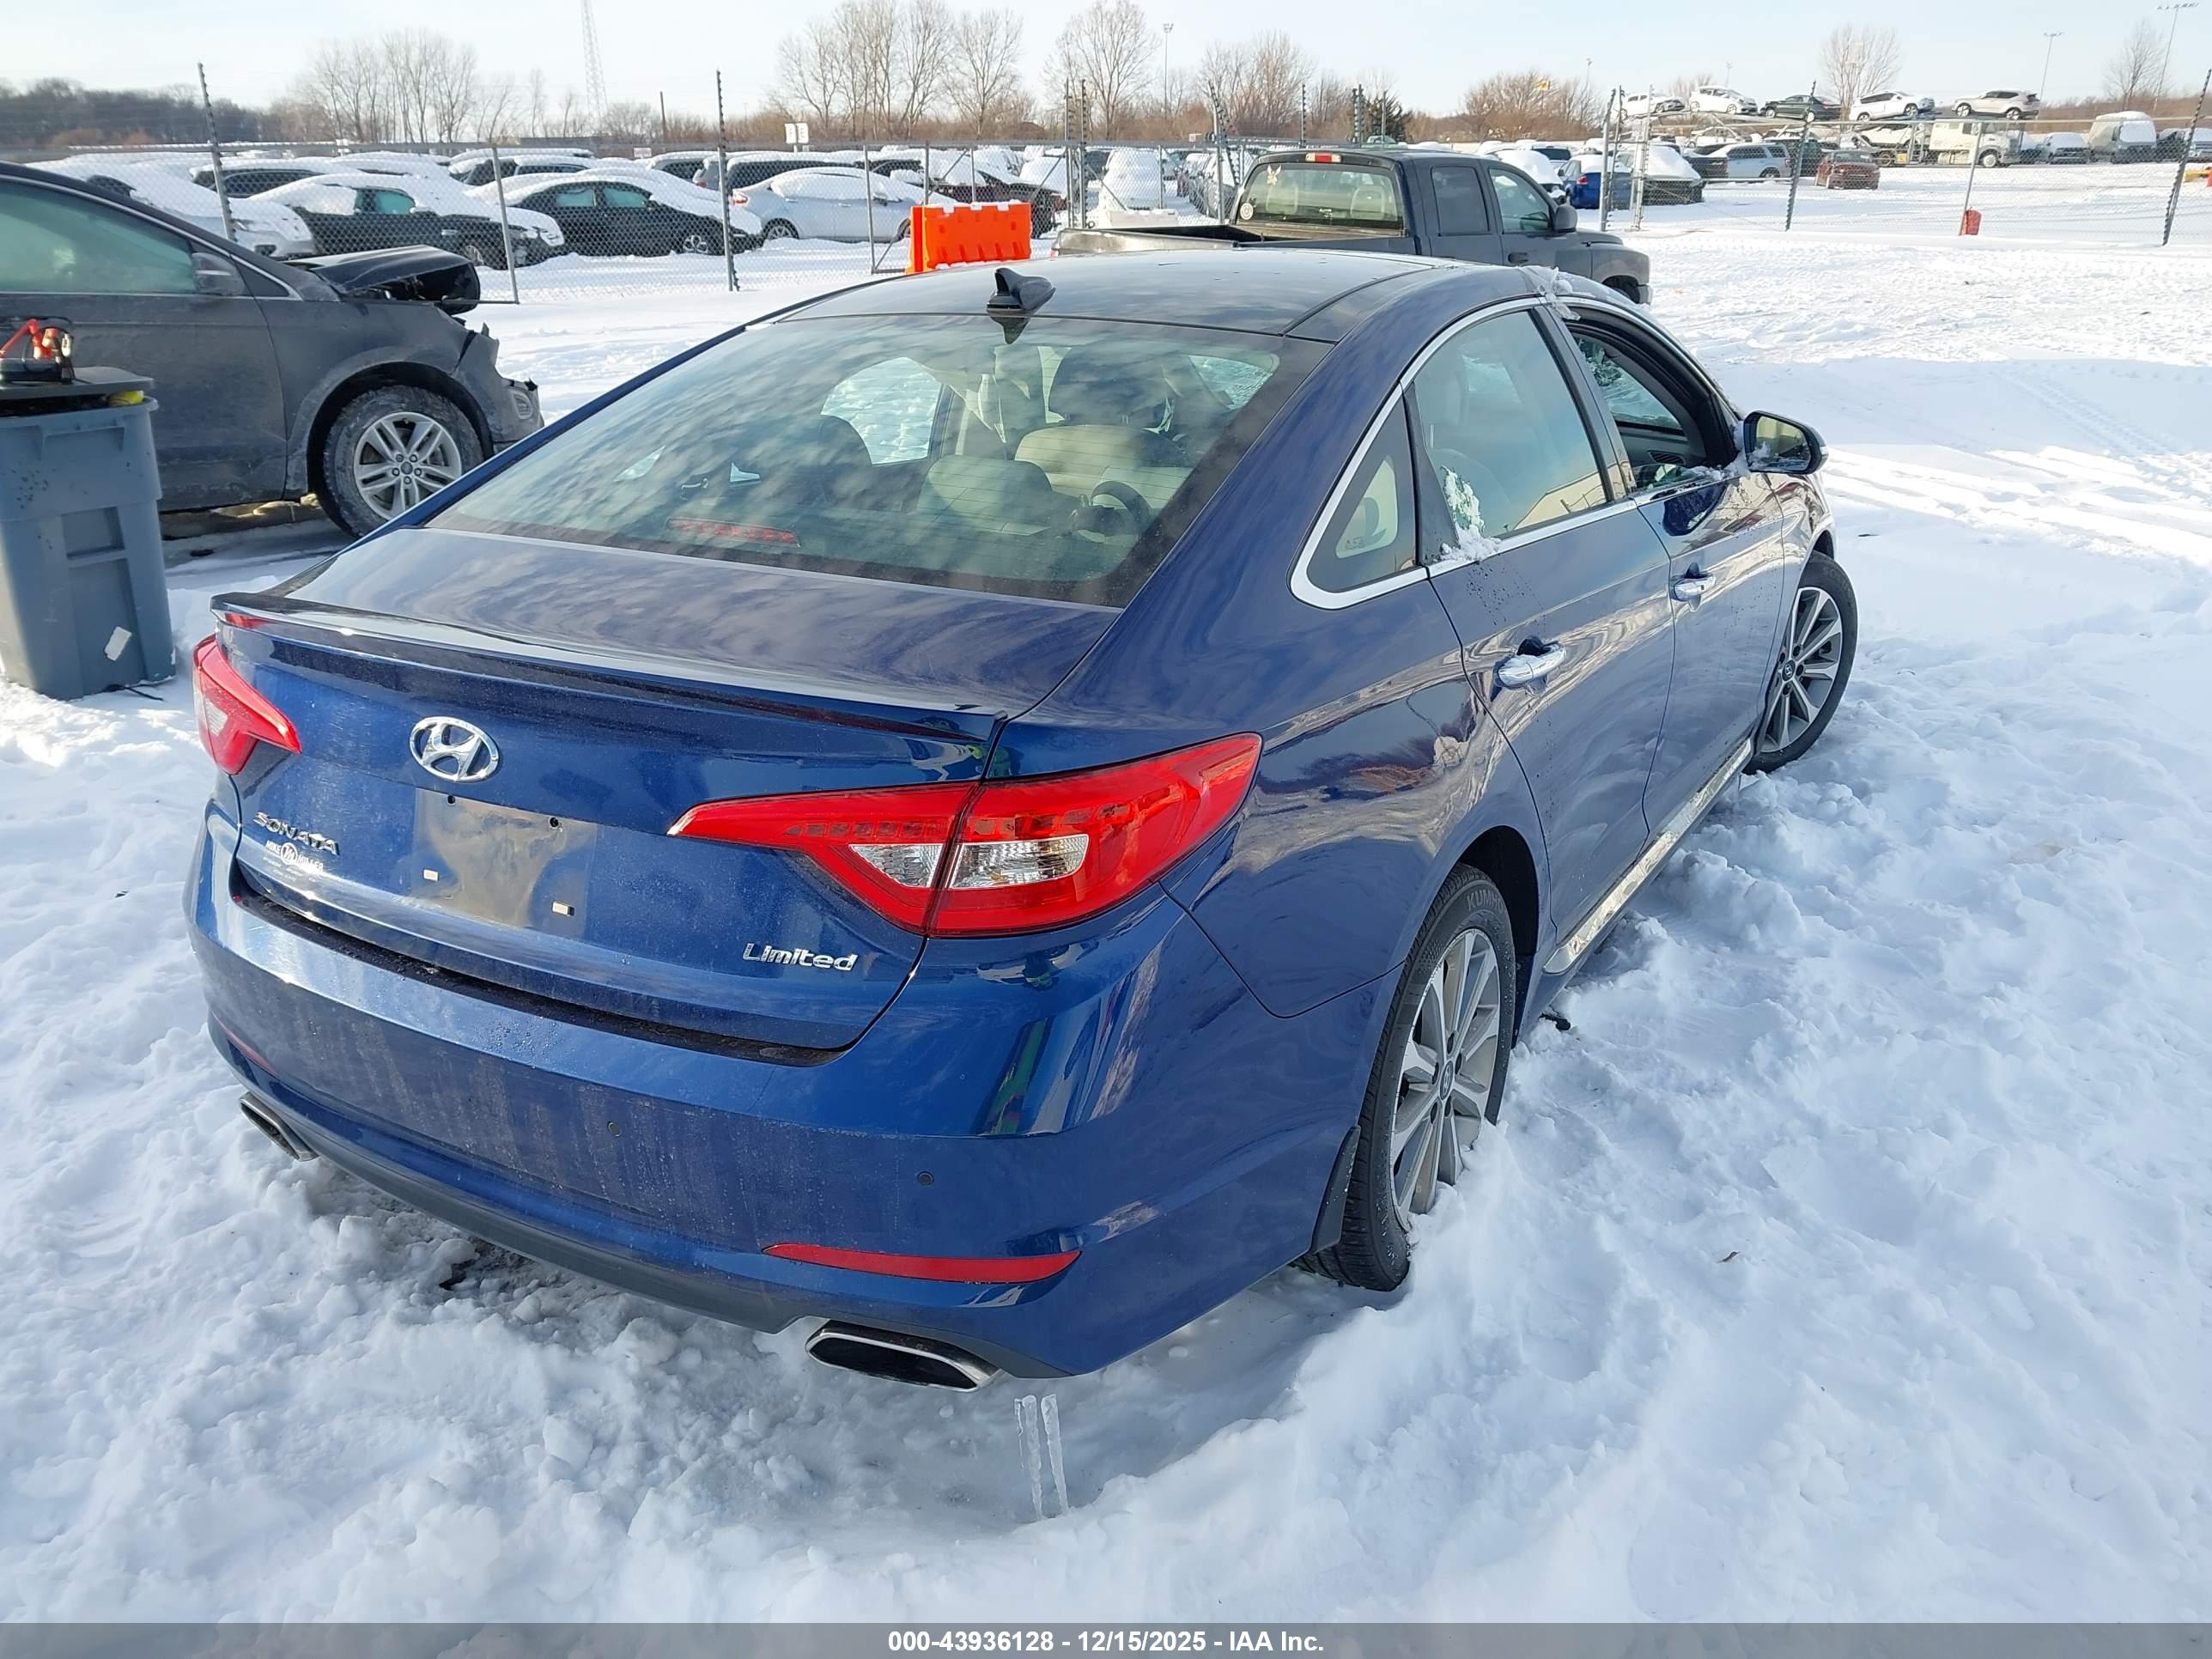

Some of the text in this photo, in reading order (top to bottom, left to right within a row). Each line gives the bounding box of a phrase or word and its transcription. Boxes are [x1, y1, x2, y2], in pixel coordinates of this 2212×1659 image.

[253, 811, 340, 856] SONATA
[264, 840, 283, 855] MIKE
[296, 854, 325, 873] MILLER
[1467, 889, 1504, 914] KUMHO
[743, 943, 859, 971] Limited
